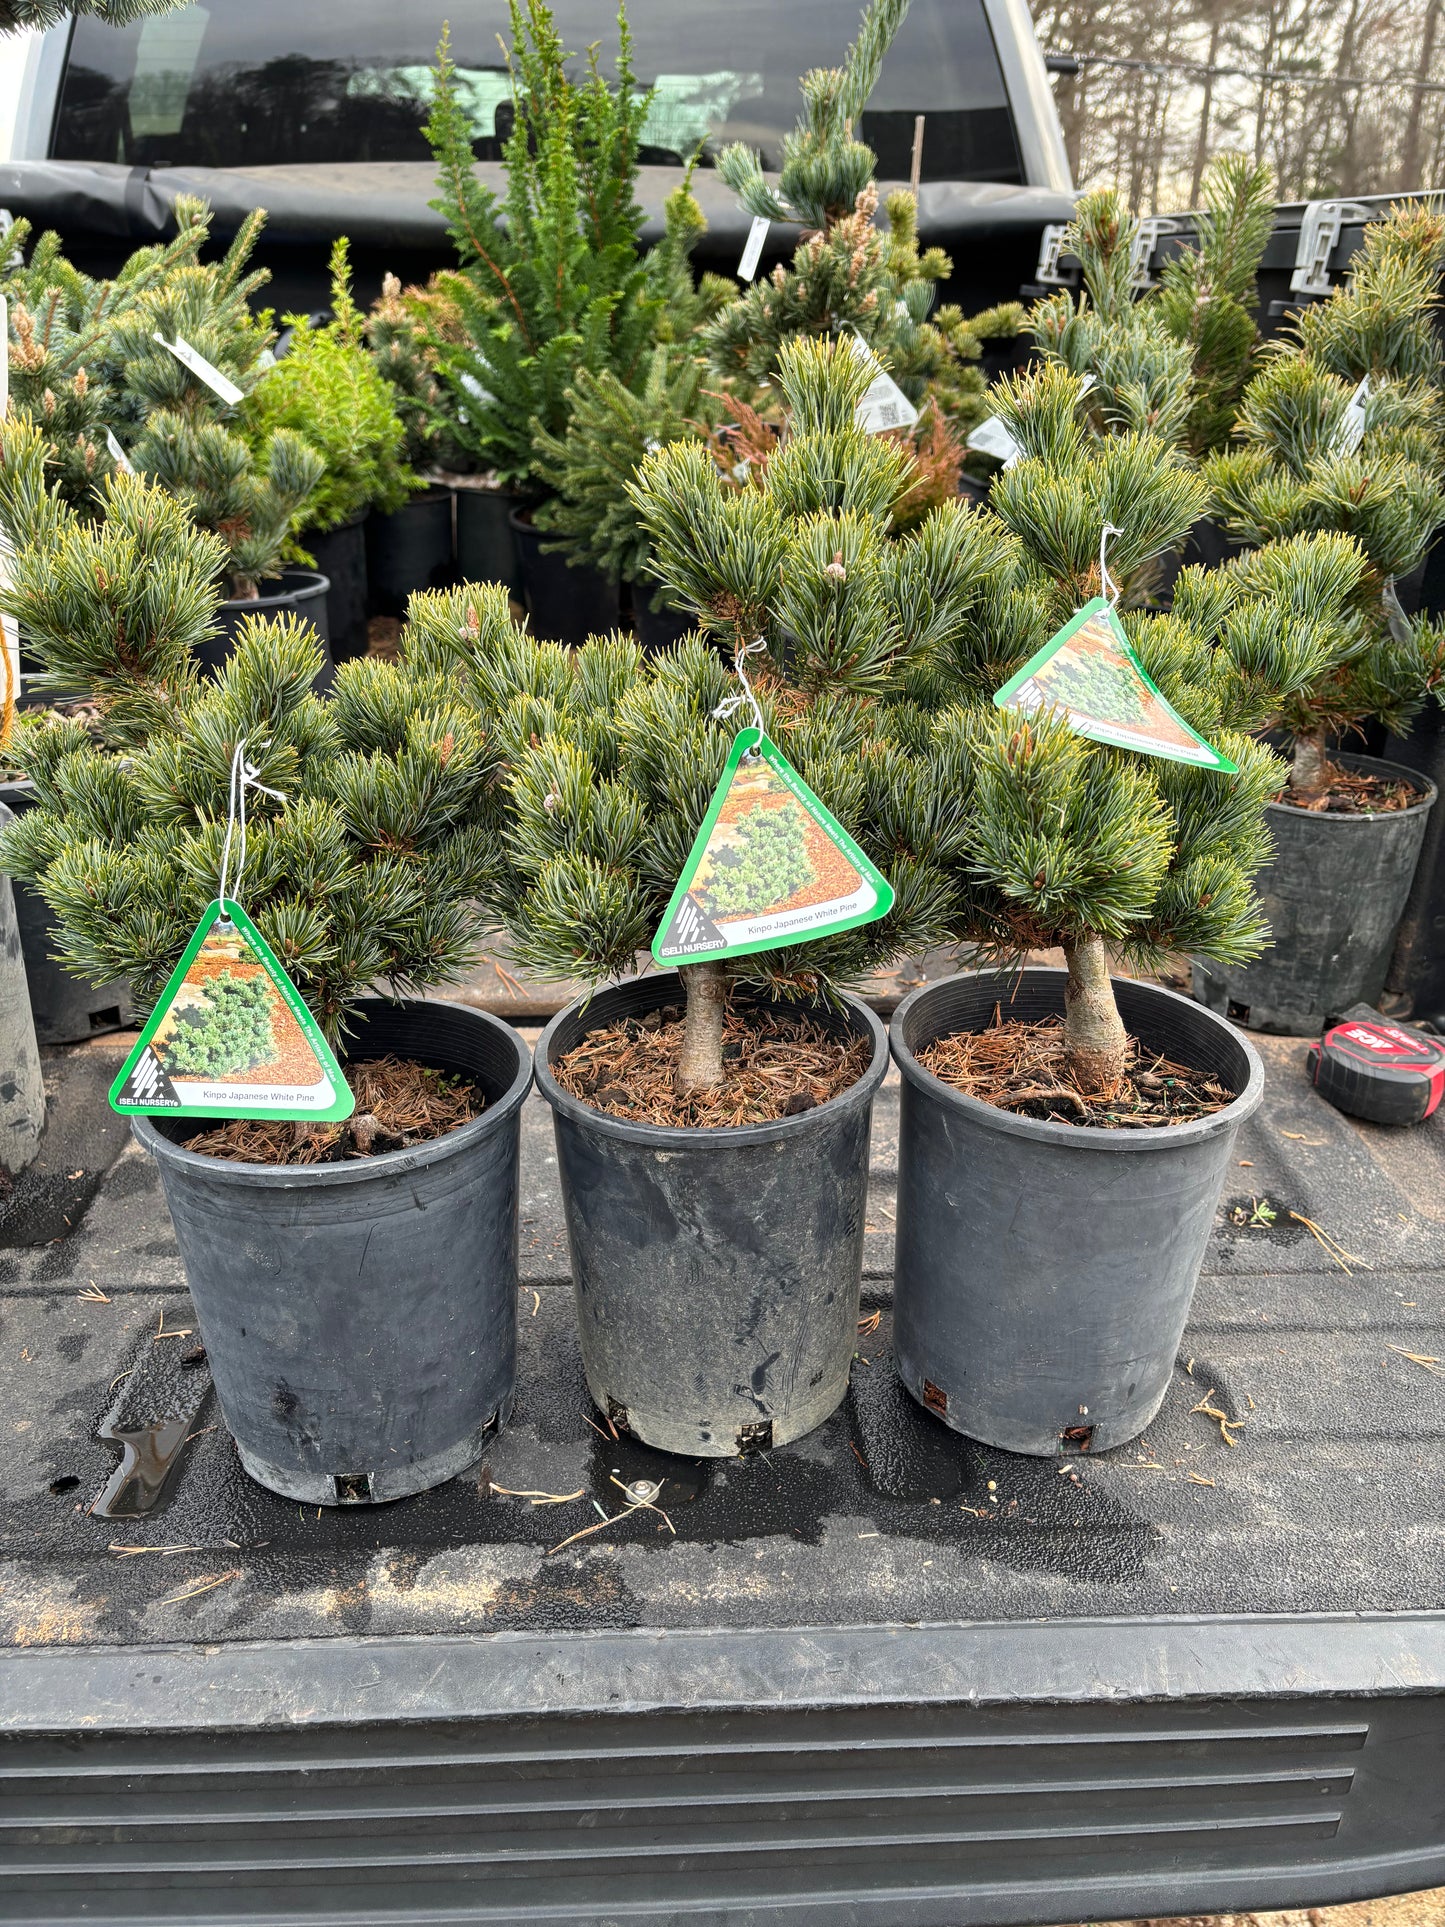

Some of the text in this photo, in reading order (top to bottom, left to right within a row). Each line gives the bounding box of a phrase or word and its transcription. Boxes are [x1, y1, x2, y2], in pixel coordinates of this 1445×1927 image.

[769, 754, 784, 773] Where
[783, 773, 792, 783] the
[791, 782, 808, 801] Beauty
[811, 806, 826, 824] Nature
[825, 824, 839, 839] Meets
[845, 849, 862, 866] Artistry
[748, 902, 857, 935] Kinpo Japanese White Pine
[662, 939, 725, 956] ISELI NURSERY
[241, 926, 256, 945] Where
[255, 946, 263, 956] the
[262, 956, 278, 977] Beauty
[281, 986, 295, 1006] Nature
[293, 1006, 306, 1024] Meets
[304, 1026, 313, 1037] The
[311, 1038, 326, 1060] Artistry
[1345, 1028, 1393, 1048] ACE
[203, 1091, 315, 1102] Kinpo Japanese White Pine
